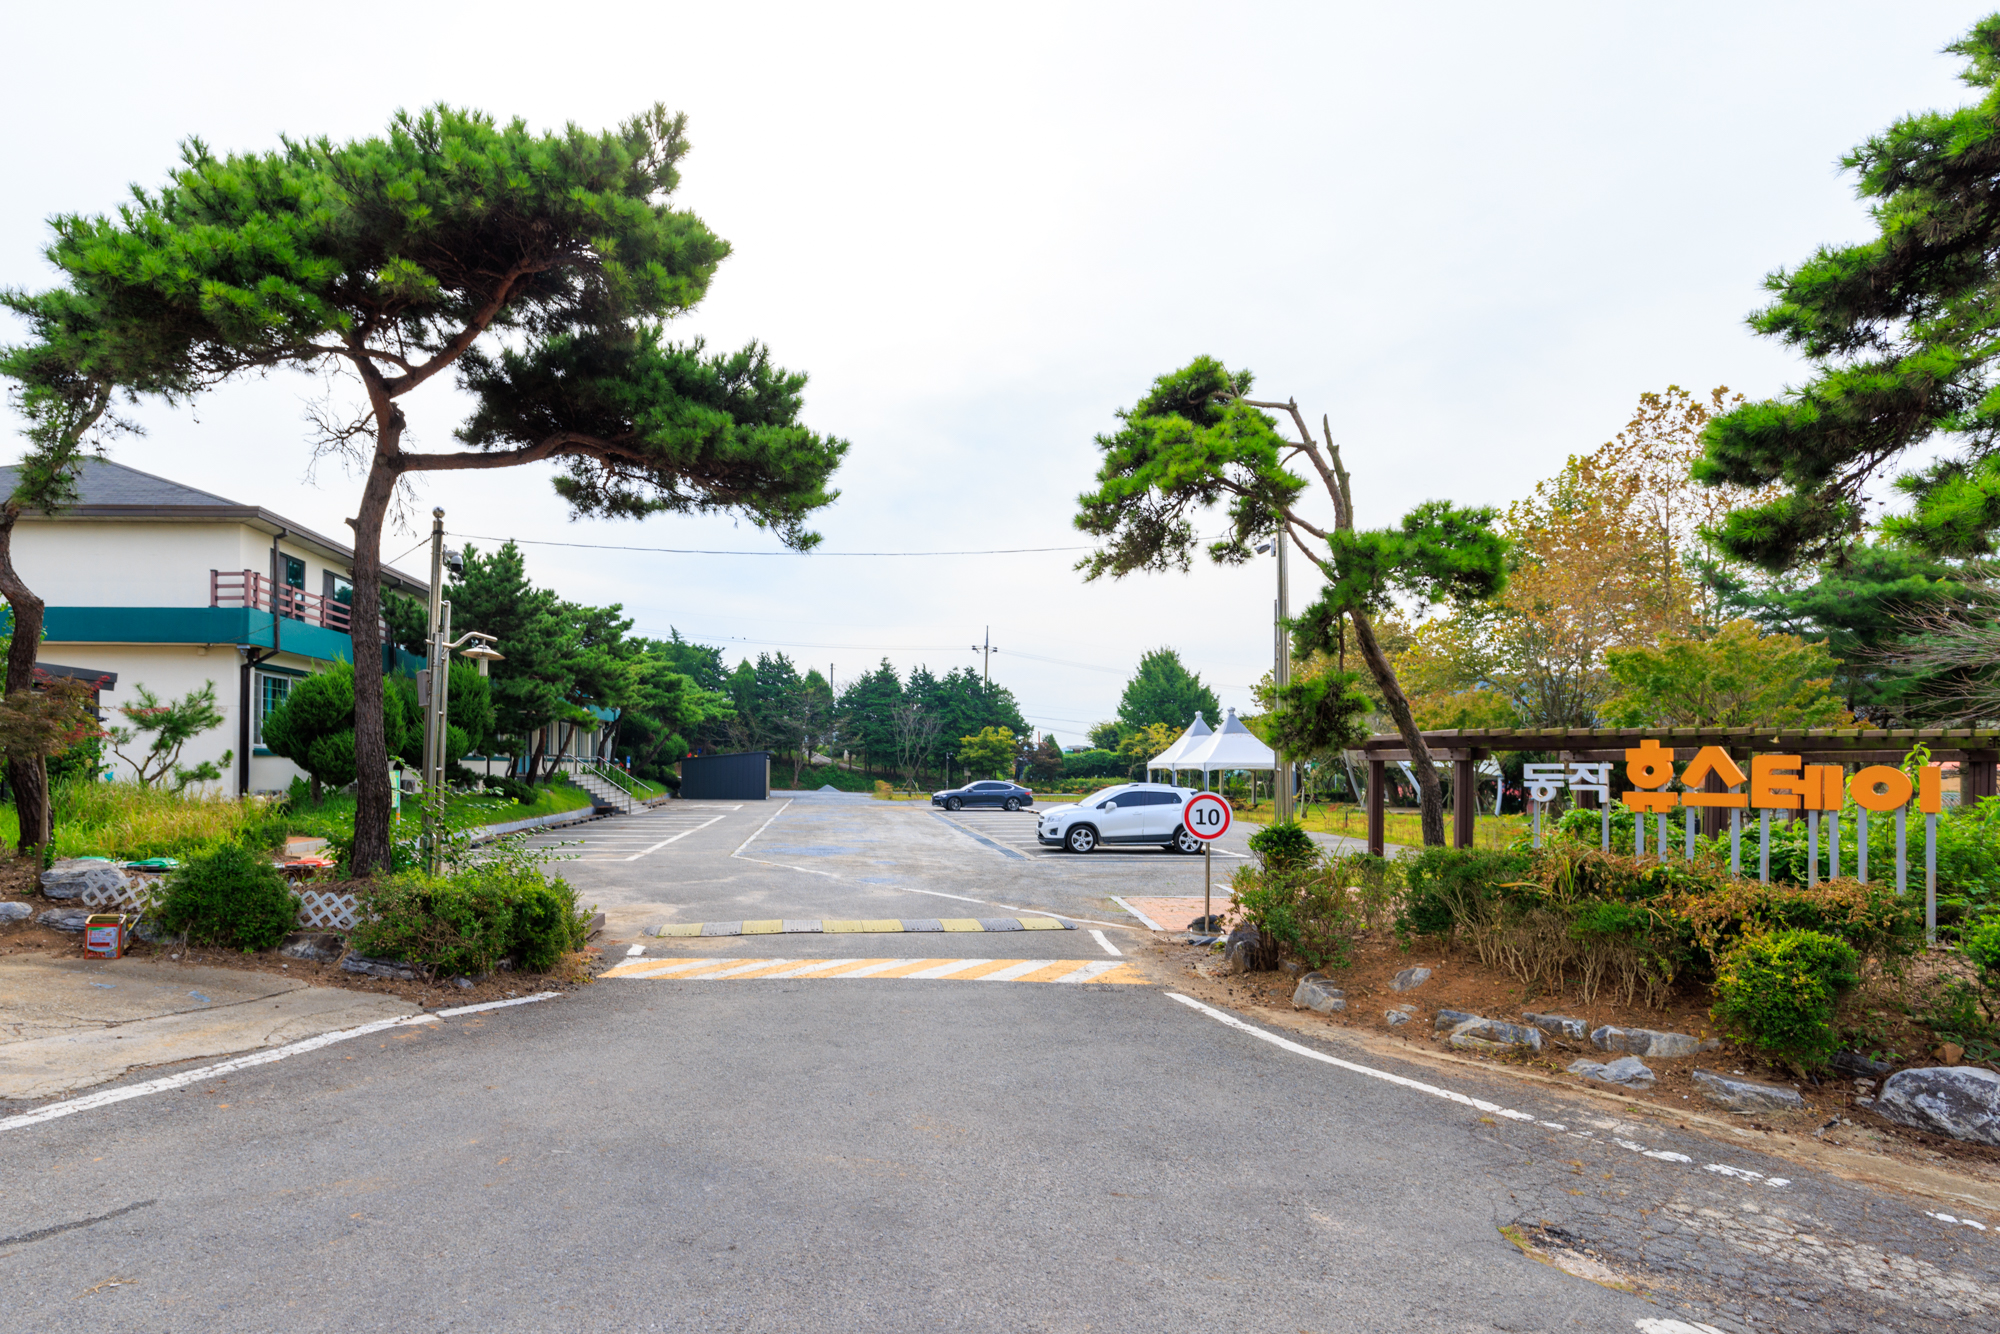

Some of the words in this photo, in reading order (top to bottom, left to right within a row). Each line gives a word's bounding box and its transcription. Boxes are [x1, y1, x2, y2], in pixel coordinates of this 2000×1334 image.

[1523, 762, 1613, 803] 동작
[1622, 739, 1941, 813] 휴스테이
[1196, 808, 1220, 826] 10
